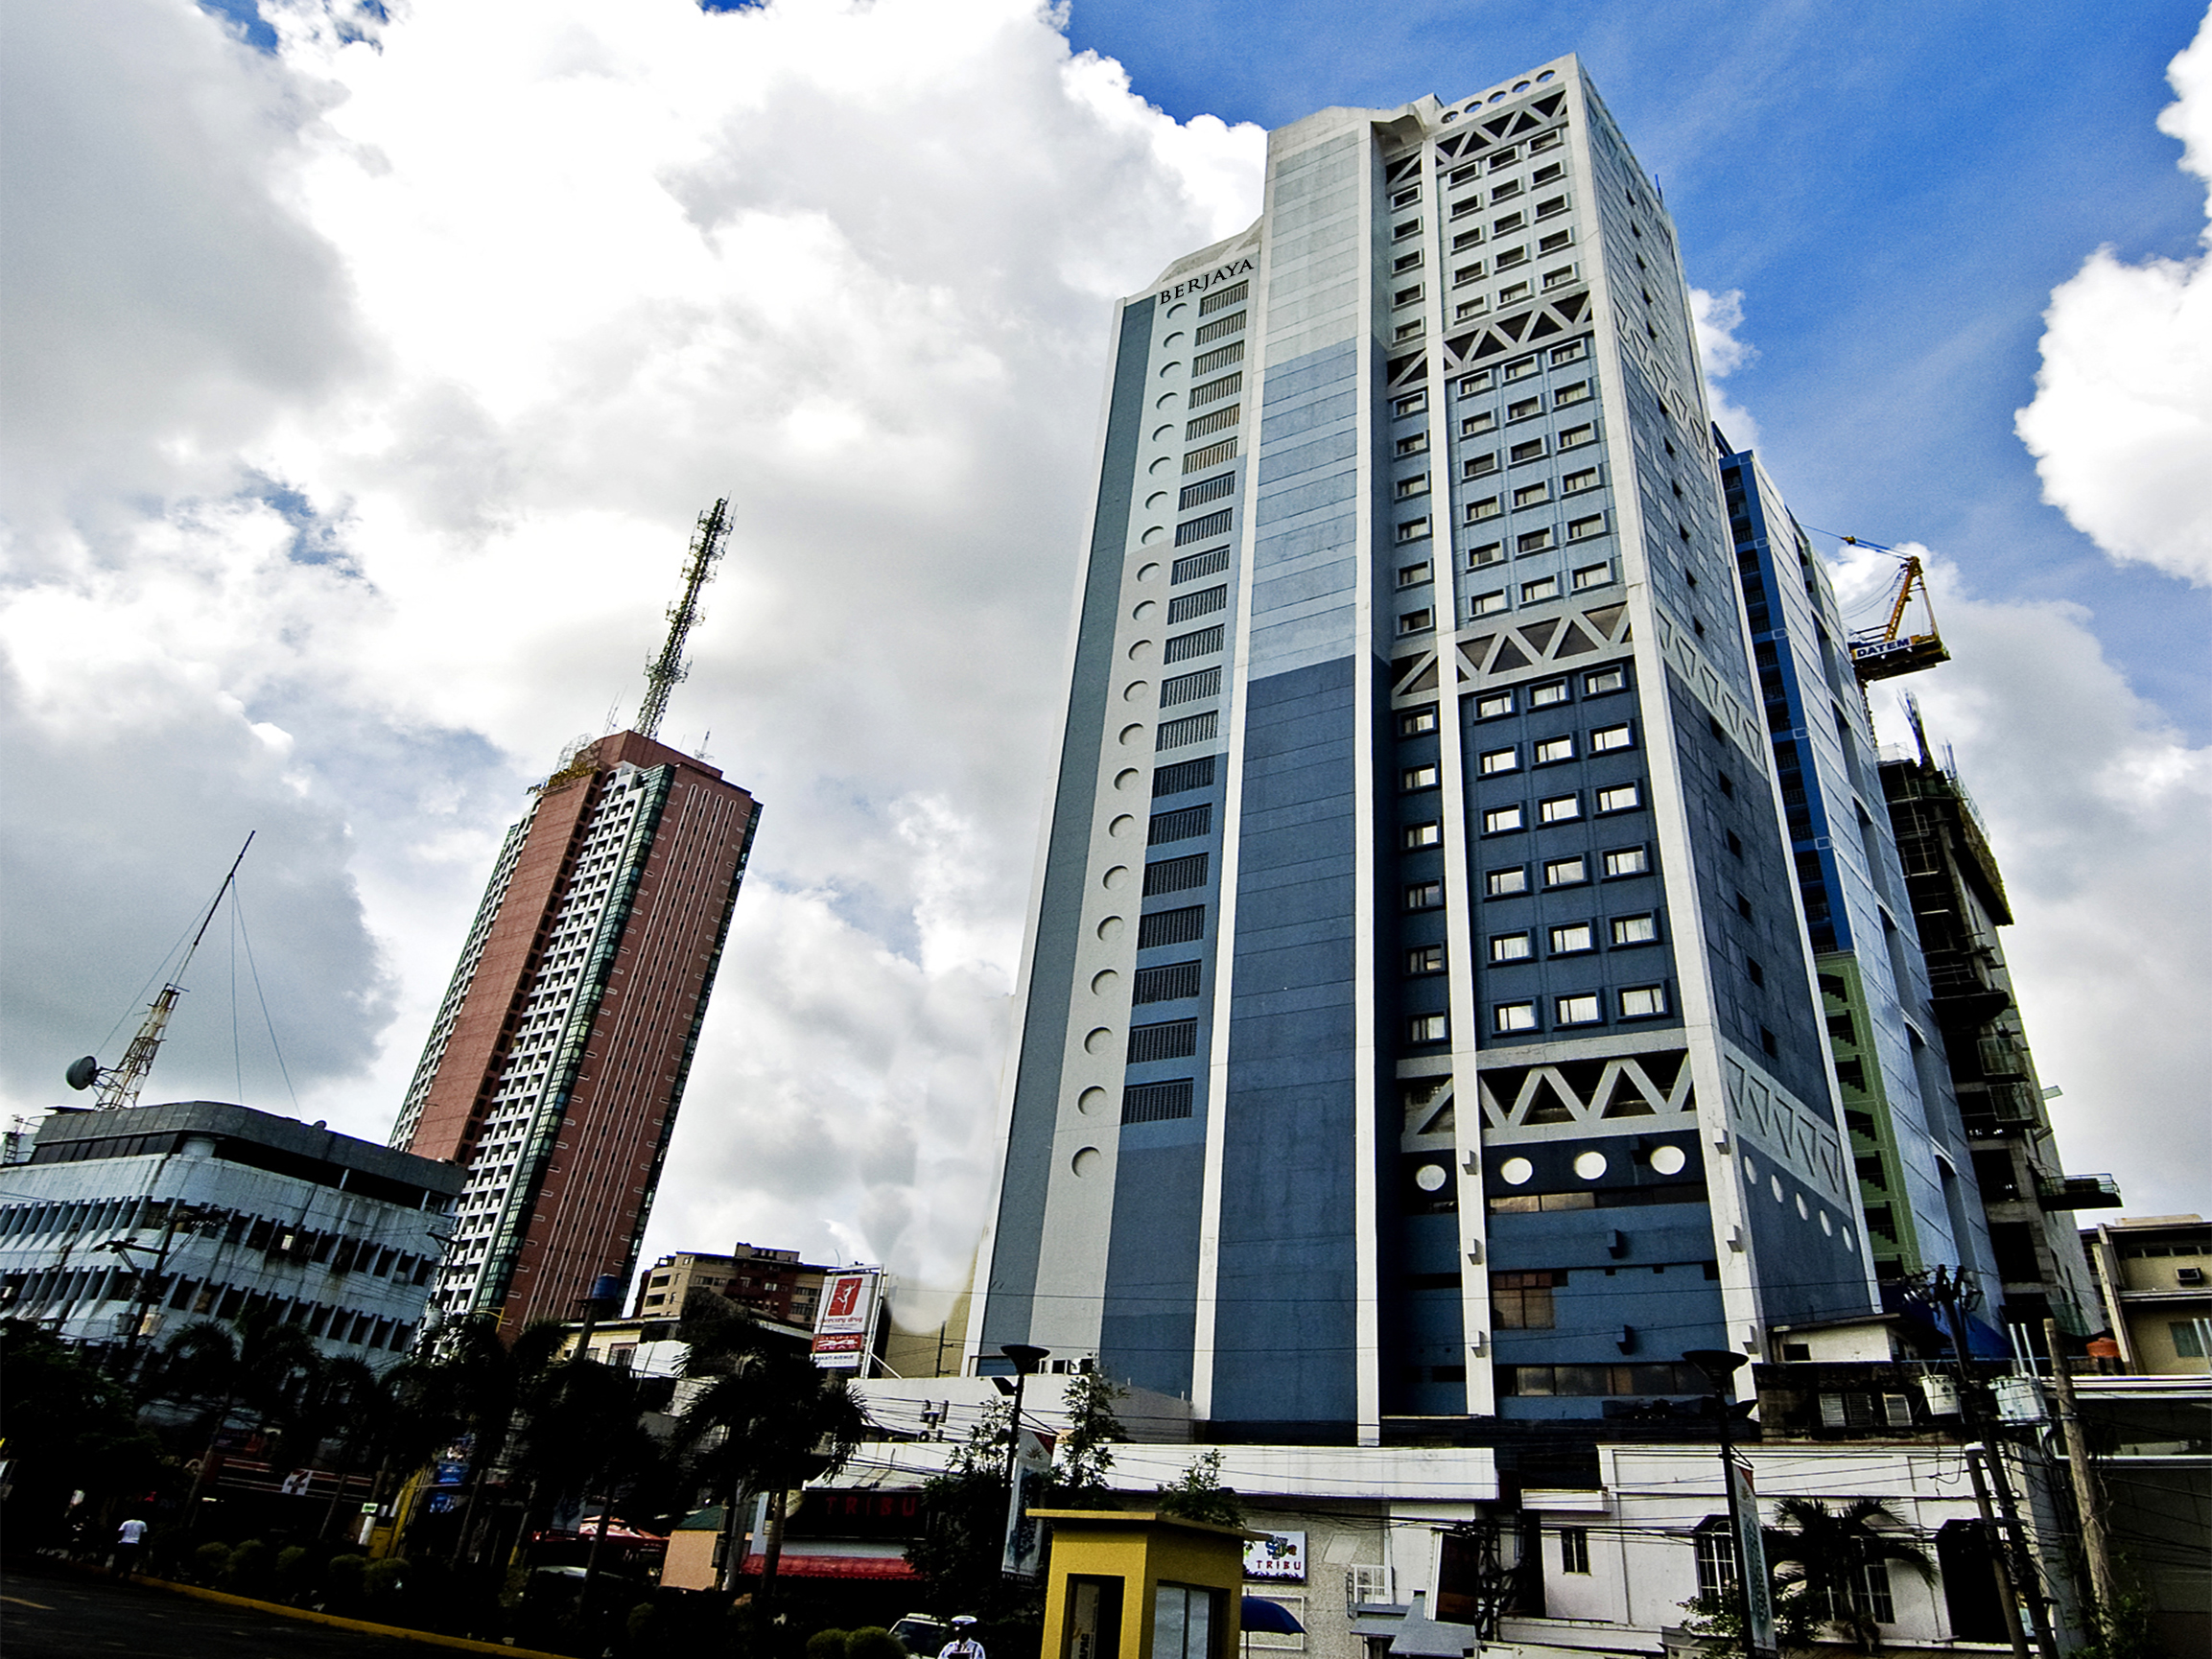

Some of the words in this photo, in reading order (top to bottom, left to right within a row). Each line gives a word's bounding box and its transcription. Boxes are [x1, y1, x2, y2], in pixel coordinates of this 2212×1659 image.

[1160, 259, 1254, 305] BERJAYA
[1857, 639, 1910, 657] DATEM
[825, 1496, 917, 1517] TRIBU
[1256, 1560, 1301, 1570] TRIBU
